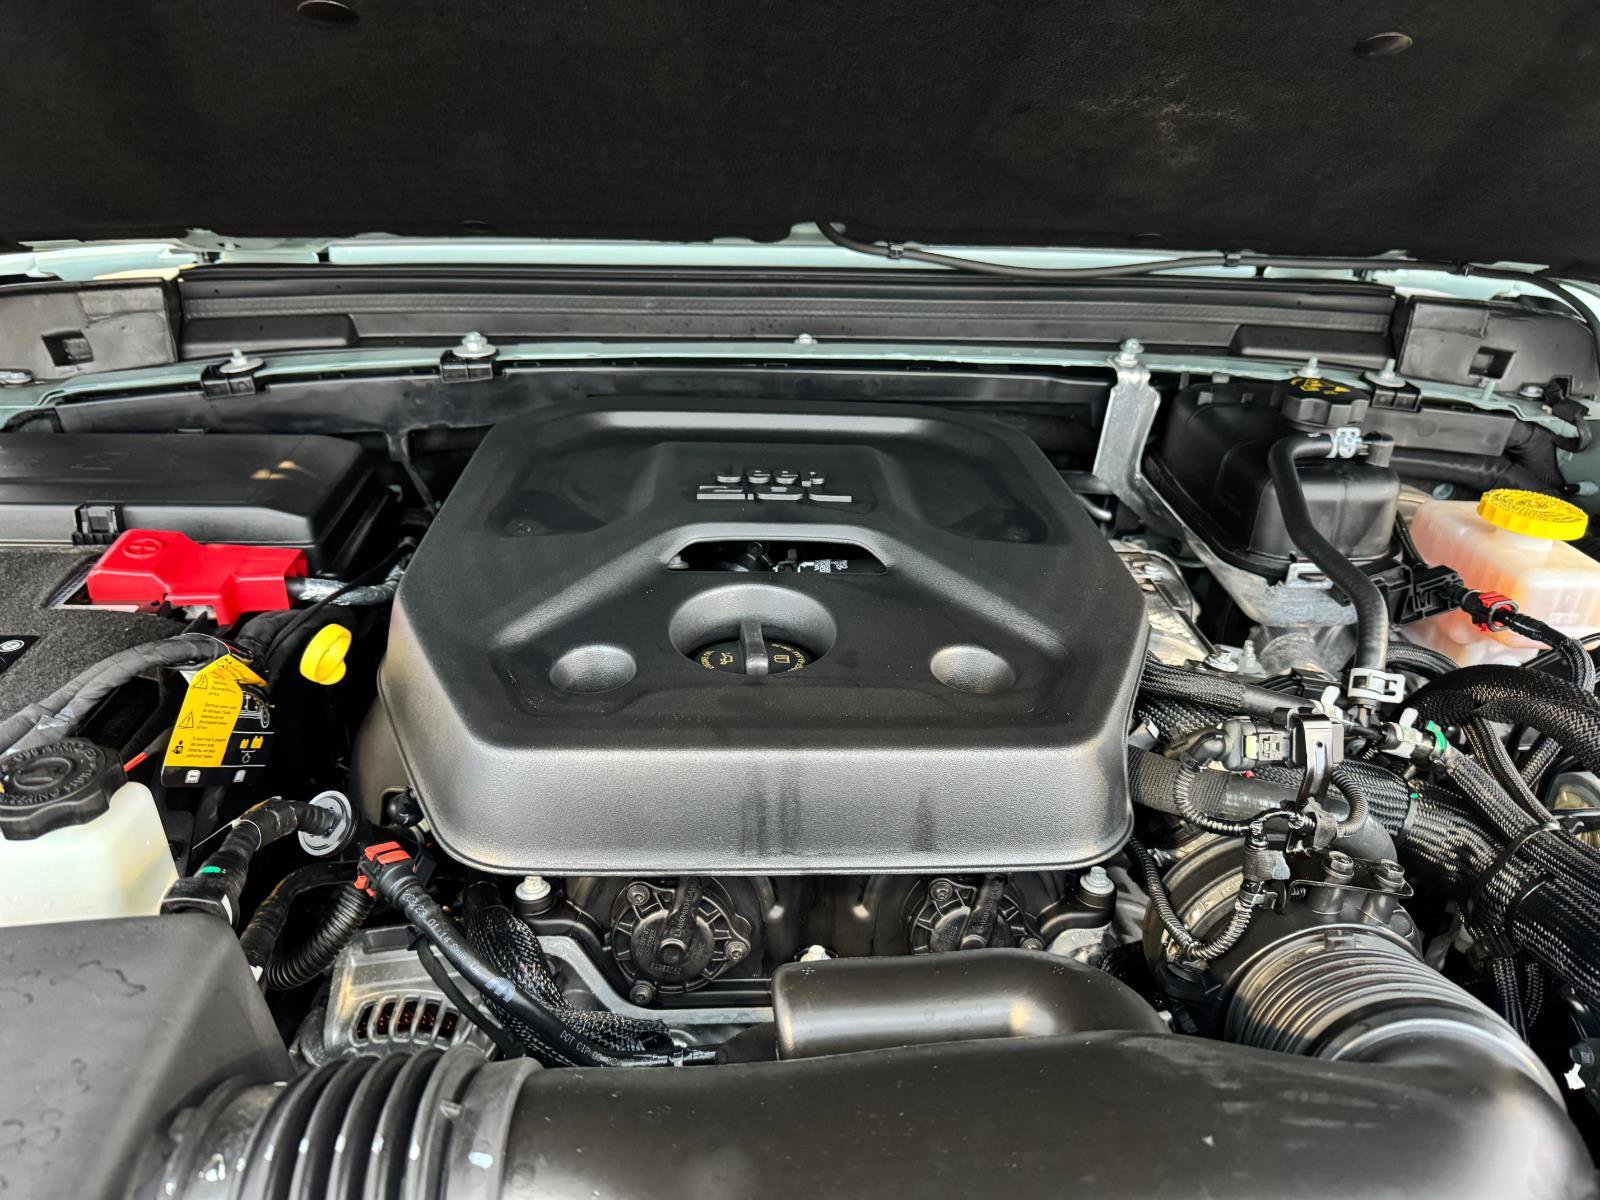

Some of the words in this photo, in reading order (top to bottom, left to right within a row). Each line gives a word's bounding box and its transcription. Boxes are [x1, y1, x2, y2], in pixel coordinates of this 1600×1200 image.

[712, 465, 825, 488] Jeep
[696, 483, 853, 502] 2.0L
[560, 1030, 575, 1047] DOT
